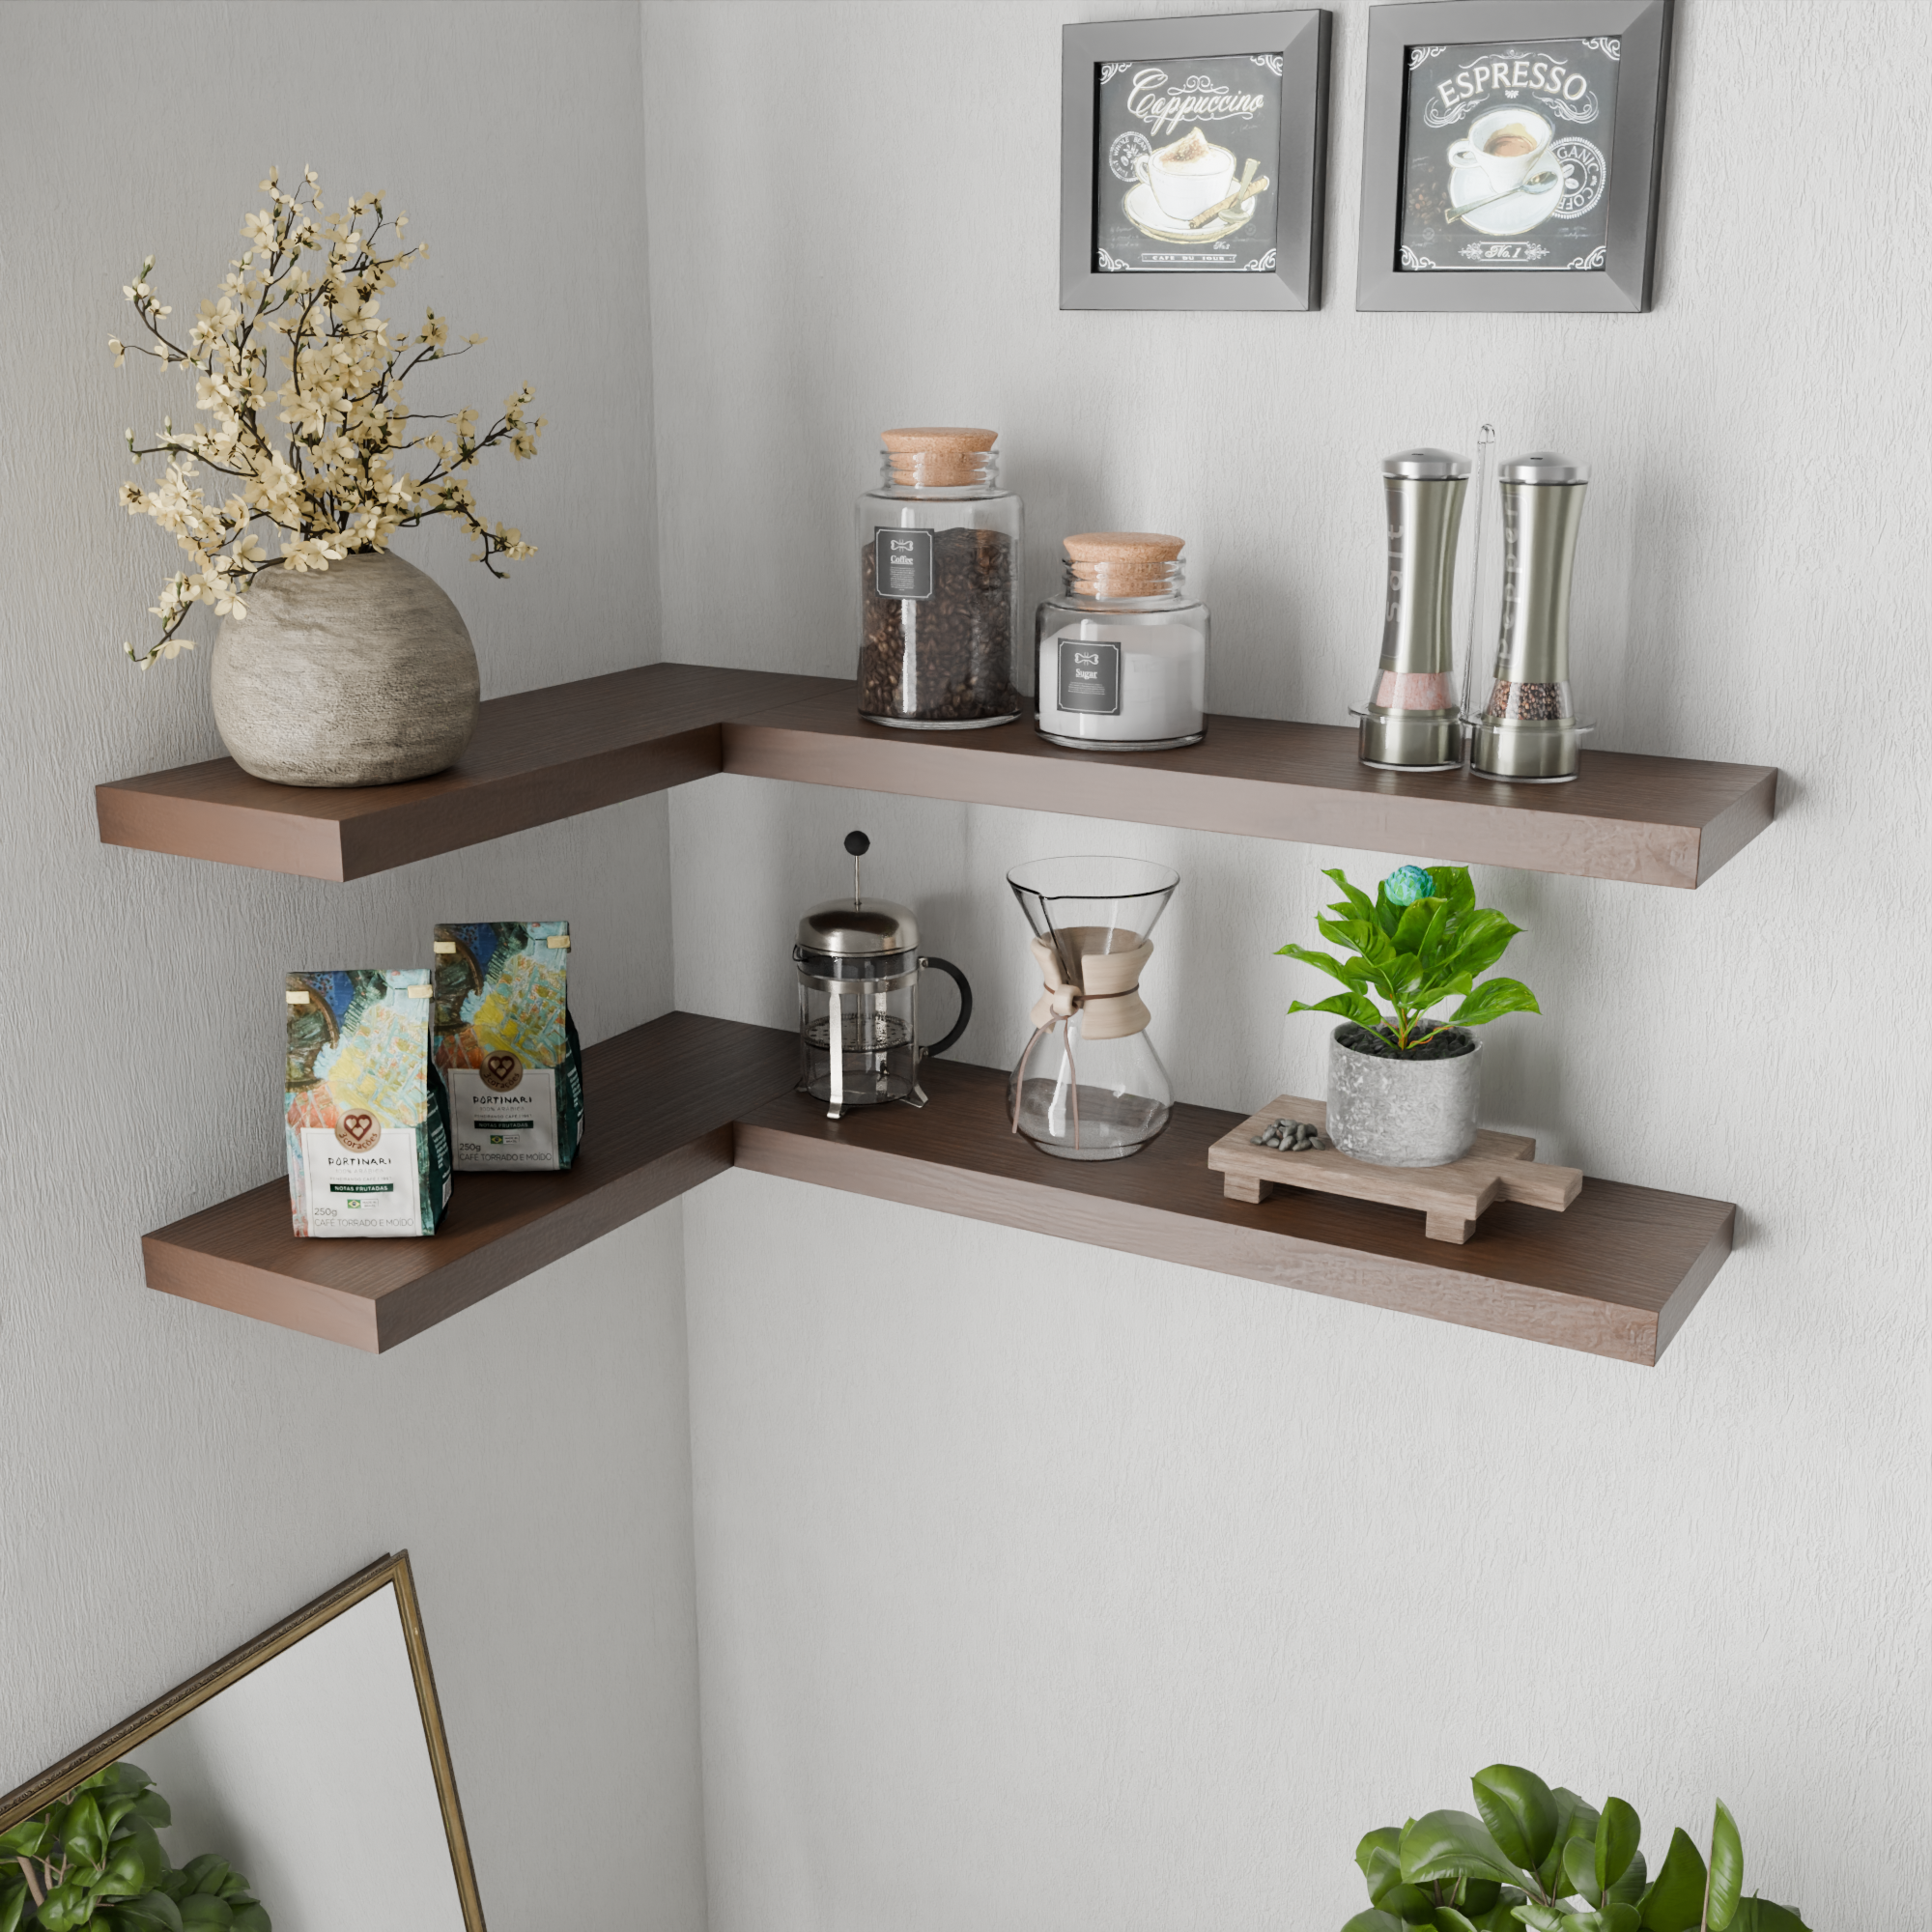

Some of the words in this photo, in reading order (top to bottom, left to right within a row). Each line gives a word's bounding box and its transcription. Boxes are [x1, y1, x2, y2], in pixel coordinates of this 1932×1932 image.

[1436, 61, 1587, 108] ESPRESSO
[1127, 68, 1264, 136] Cappuccino
[1113, 136, 1129, 156] WHOLE
[1133, 136, 1148, 152] BEAN
[1556, 145, 1600, 174] GANIC
[1557, 186, 1594, 211] COFF
[1512, 247, 1521, 258] 1
[891, 554, 914, 564] Coffee
[1386, 523, 1404, 623] Salt
[1496, 501, 1523, 660] Pepper
[1075, 668, 1097, 680] Sugar
[473, 1095, 532, 1104] PORTINARI
[327, 1157, 391, 1166] PORTINARI
[460, 1152, 478, 1161] CAFÉ
[526, 1152, 552, 1161] MOÍDO
[314, 1208, 338, 1217] 250g
[314, 1217, 336, 1227] CAFÉ
[337, 1218, 378, 1227] TORRADO
[380, 1218, 384, 1227] E
[385, 1217, 414, 1227] MOÍDO
